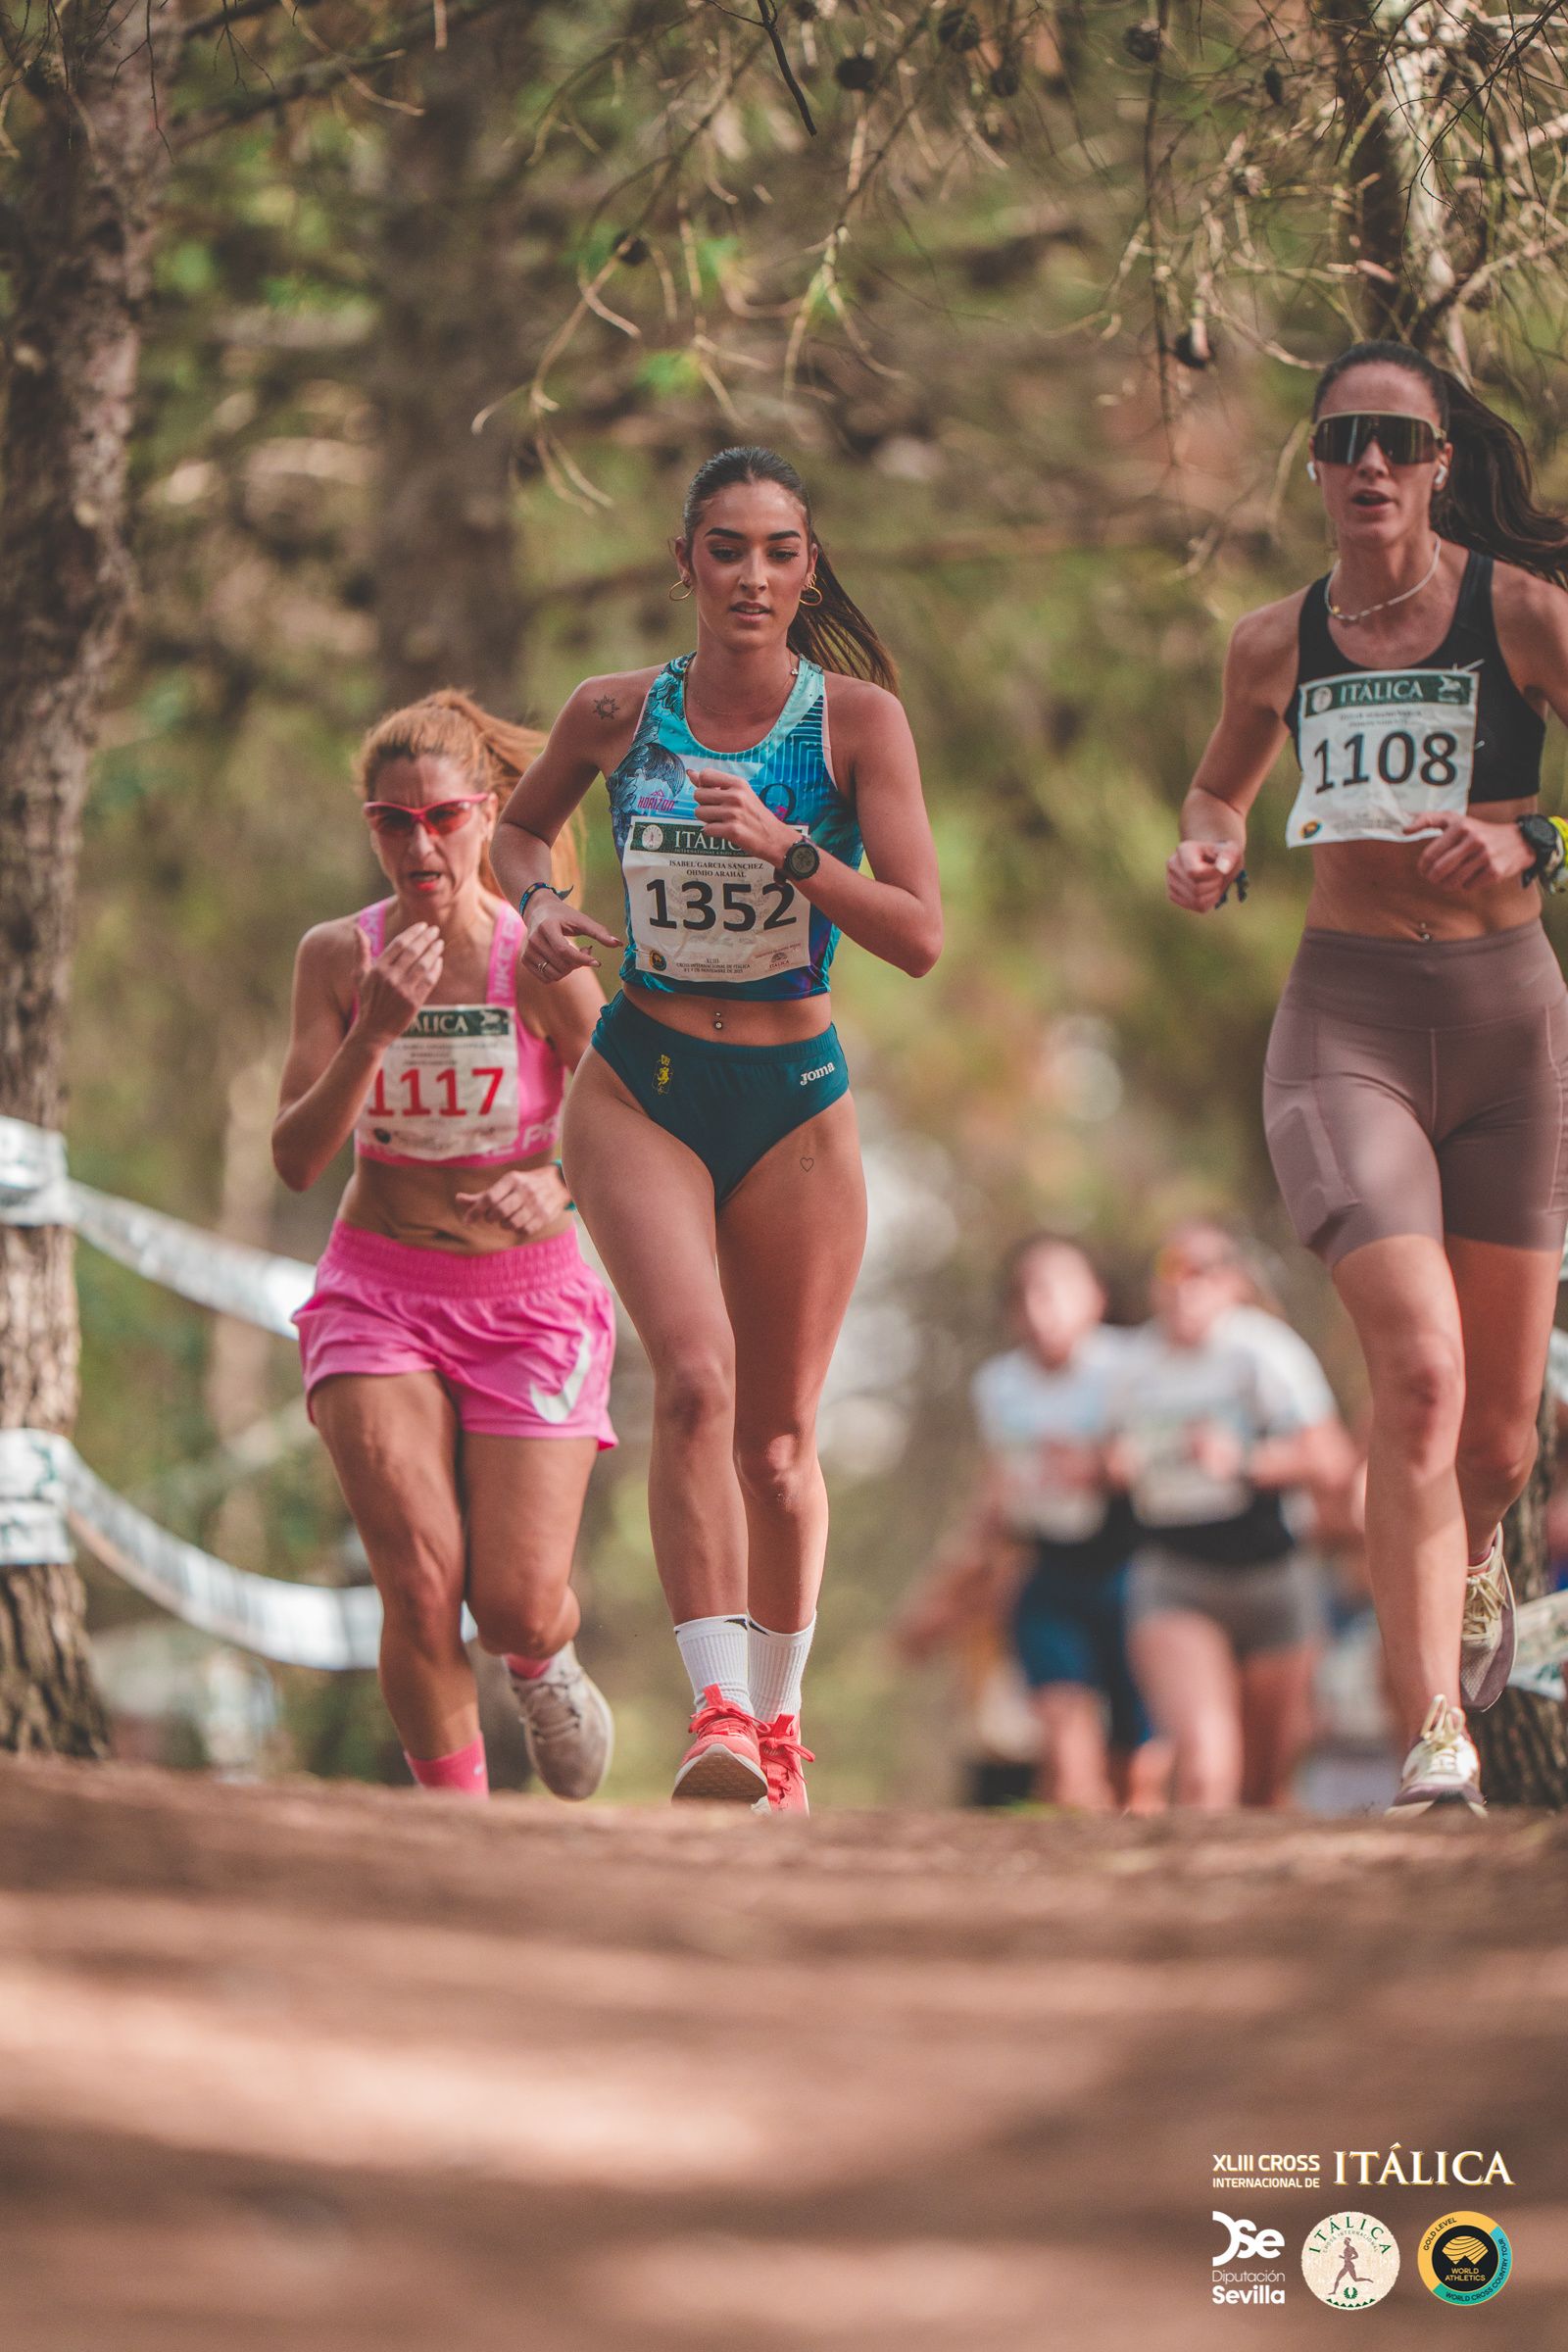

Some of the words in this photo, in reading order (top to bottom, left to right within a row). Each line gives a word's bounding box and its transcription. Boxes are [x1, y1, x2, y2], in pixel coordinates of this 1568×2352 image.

[1314, 730, 1458, 795] 1108
[647, 878, 797, 932] 1352
[368, 1067, 504, 1117] 1117
